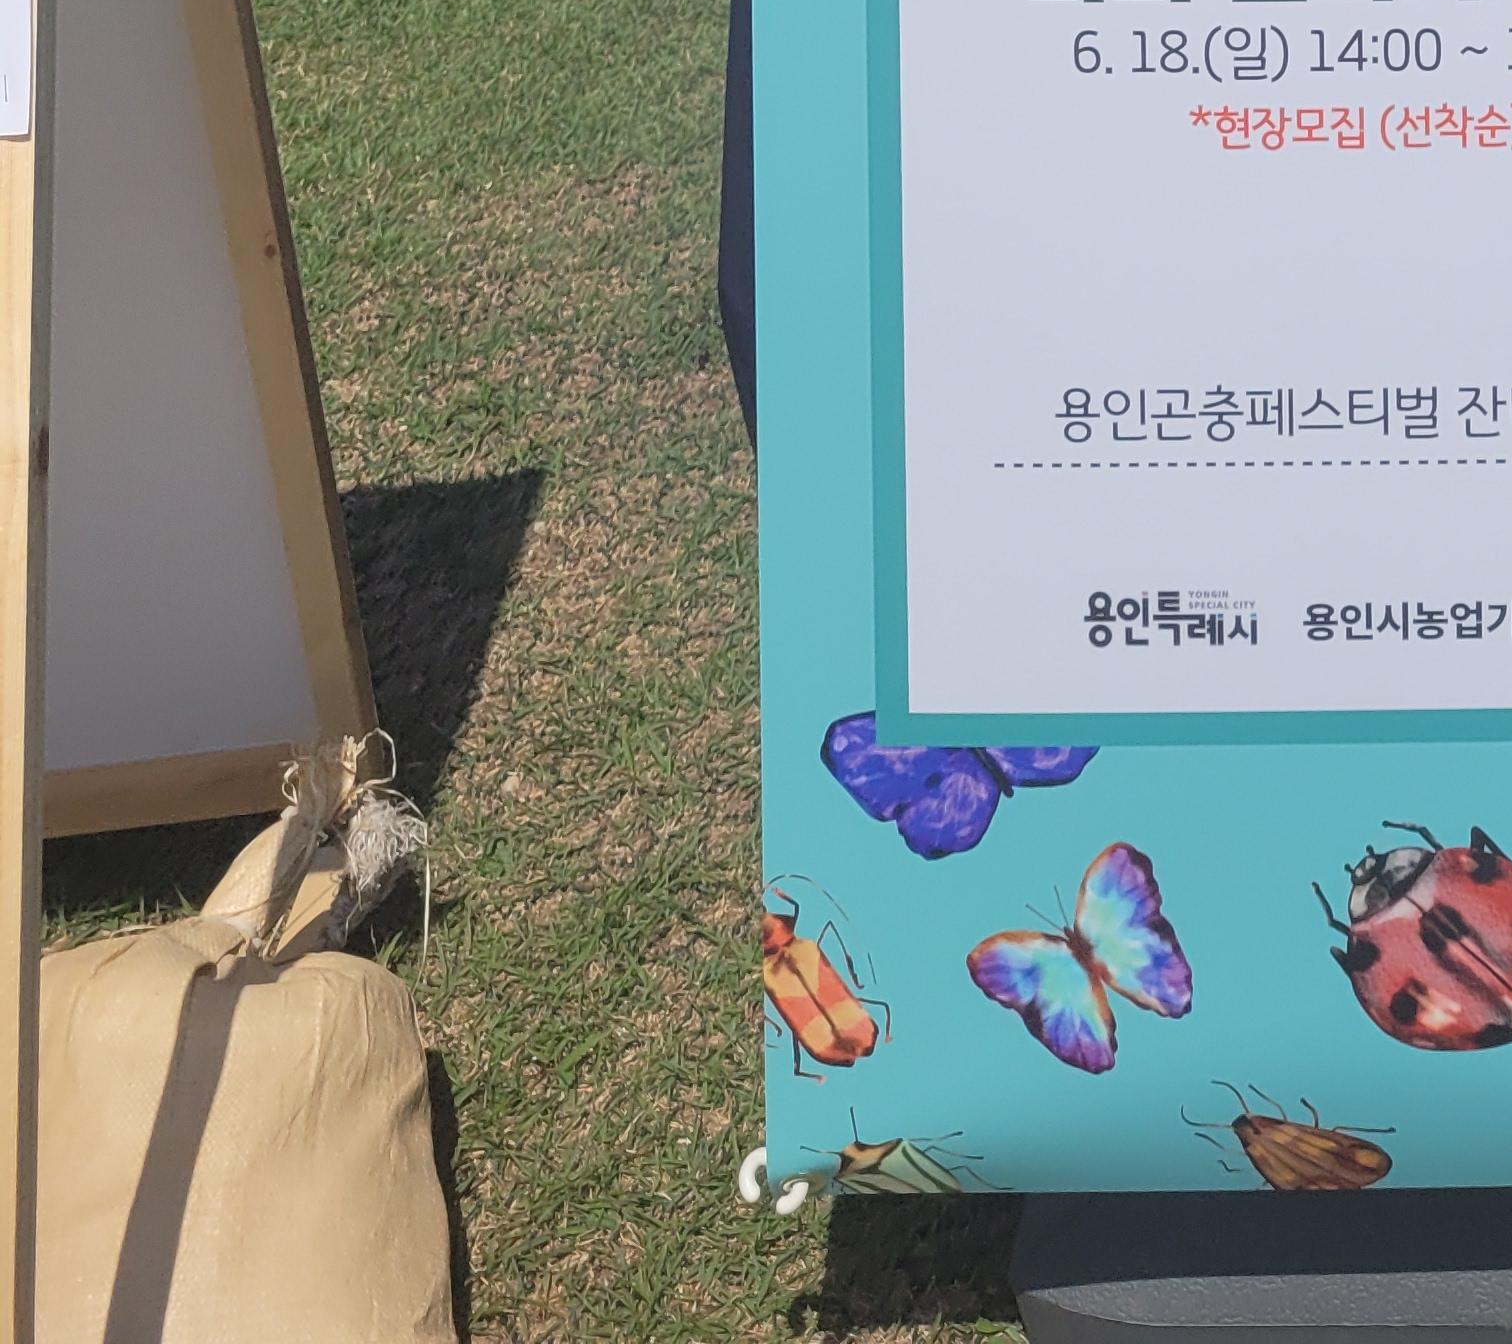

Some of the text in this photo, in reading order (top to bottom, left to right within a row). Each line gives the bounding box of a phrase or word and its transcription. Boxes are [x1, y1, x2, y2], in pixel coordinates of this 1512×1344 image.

[1073, 29, 1113, 75] 6.
[1131, 24, 1289, 84] 18.(일)
[1309, 27, 1442, 72] 14:00
[1054, 384, 1439, 444] 용인곤충페스티벌
[1083, 590, 1258, 648] 용인특례시
[1188, 590, 1229, 599] YONGIN
[1188, 601, 1256, 610] SPECIAL CITY
